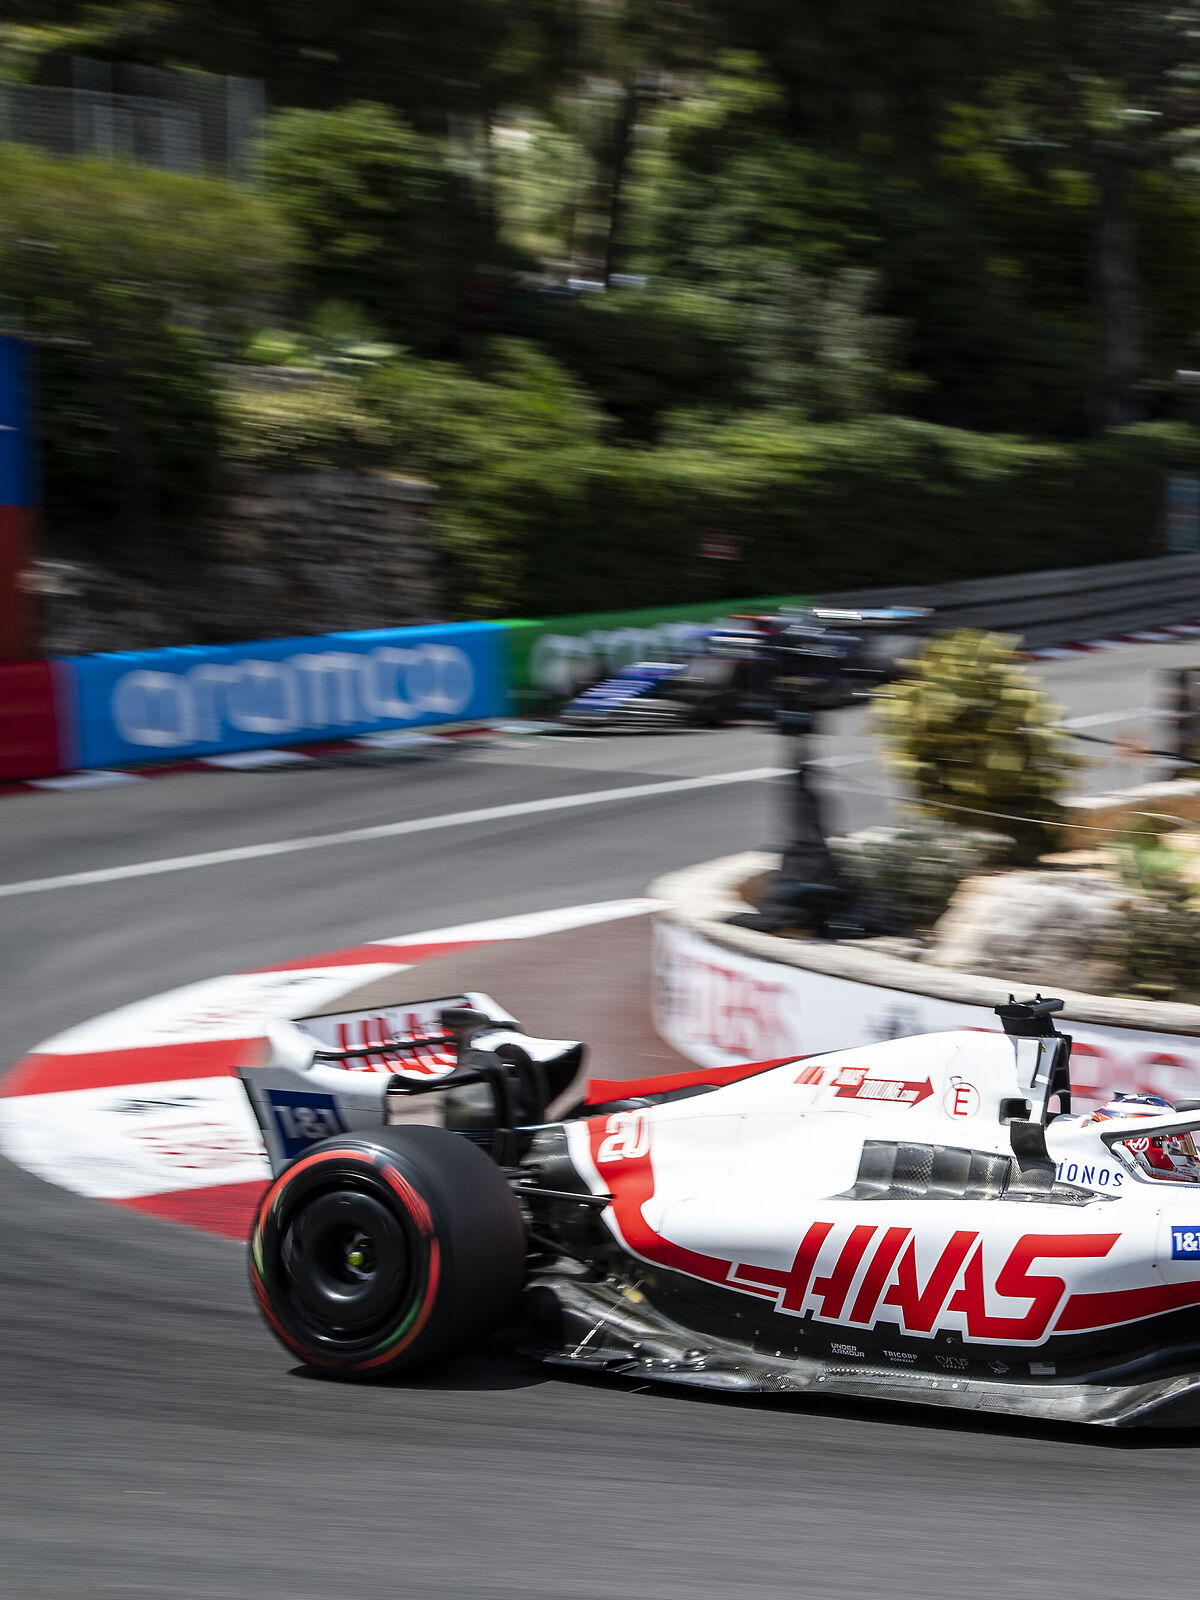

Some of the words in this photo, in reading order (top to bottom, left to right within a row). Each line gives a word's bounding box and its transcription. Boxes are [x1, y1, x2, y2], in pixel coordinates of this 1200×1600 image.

[111, 642, 475, 749] aramco
[953, 1088, 971, 1116] E
[274, 1105, 337, 1140] 1&1
[596, 1106, 653, 1163] 20
[1057, 1162, 1125, 1187] IONOS
[735, 1221, 1122, 1341] HAAS
[830, 1342, 857, 1352] UNDER
[831, 1348, 866, 1358] ARMOUR
[882, 1350, 918, 1360] TRICORP
